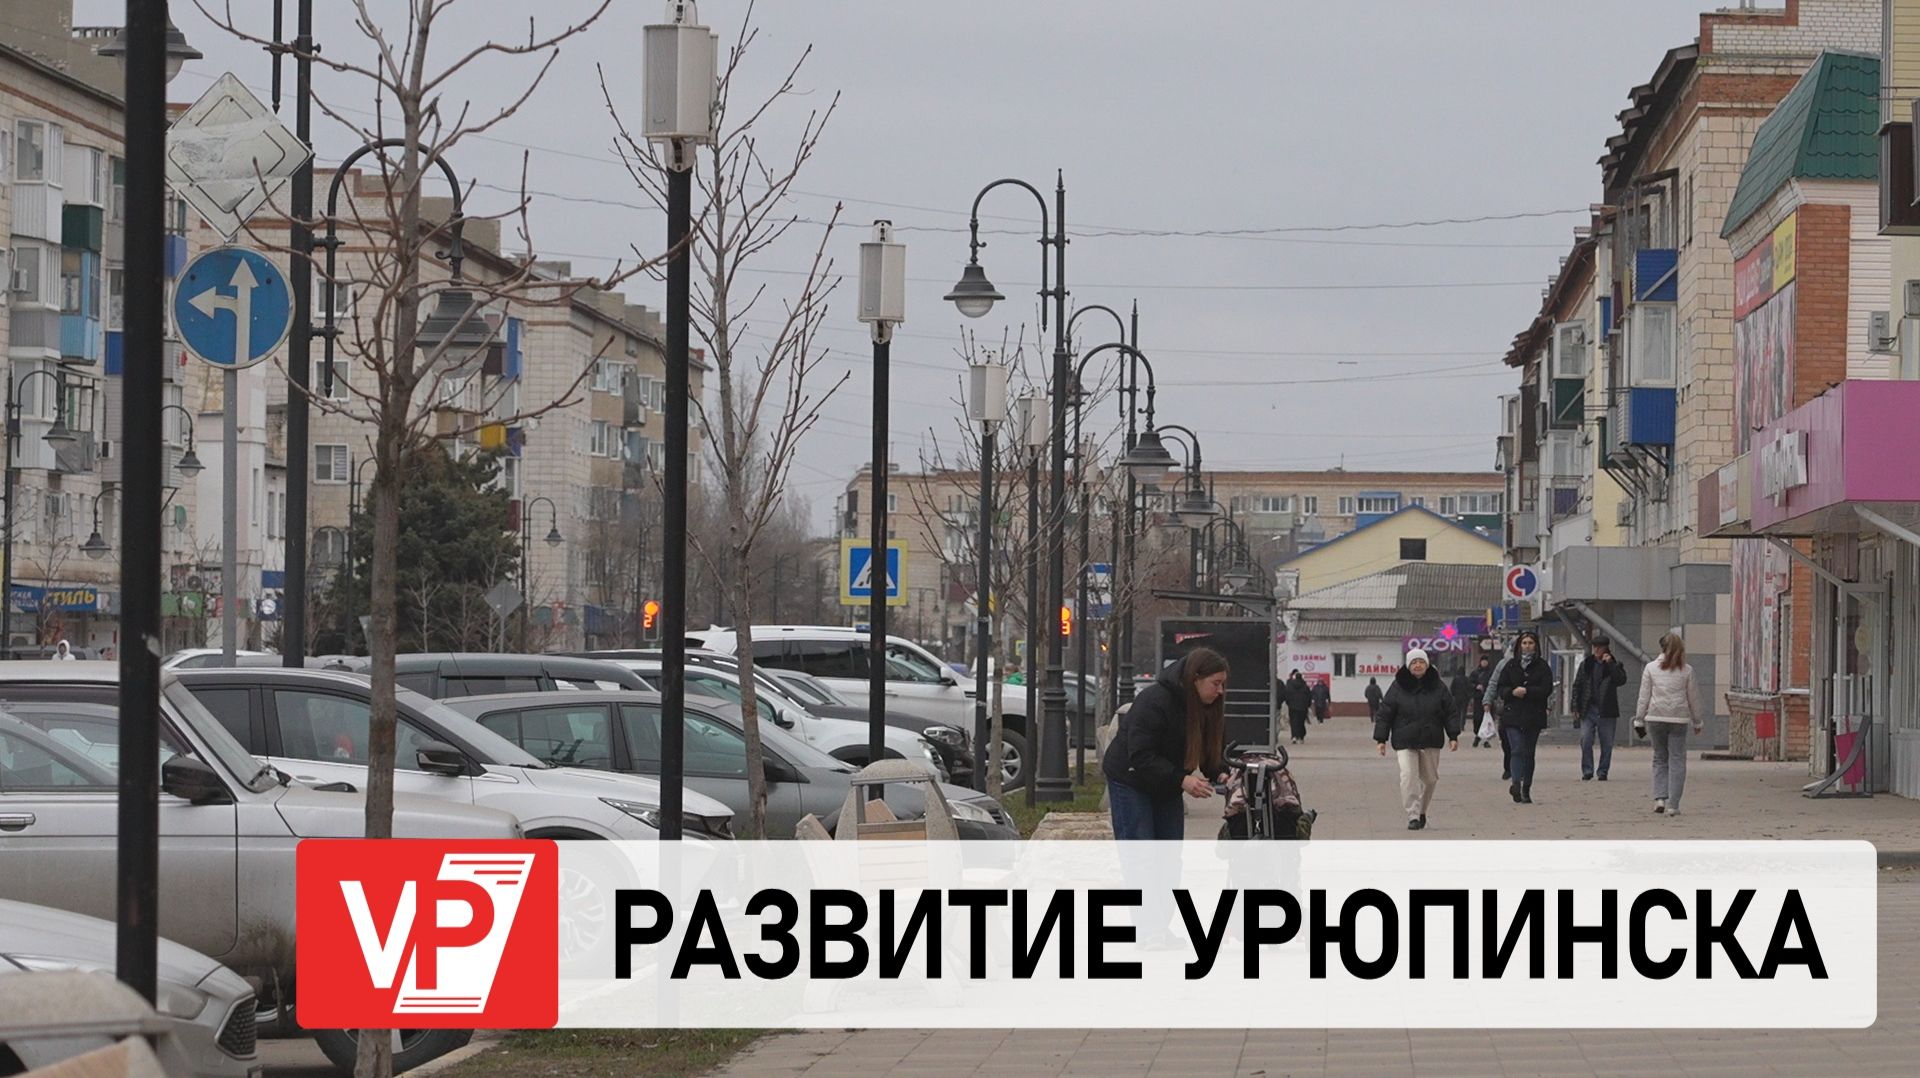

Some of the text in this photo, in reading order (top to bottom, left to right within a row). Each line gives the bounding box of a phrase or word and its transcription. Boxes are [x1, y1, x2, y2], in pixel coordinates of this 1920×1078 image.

[643, 614, 652, 628] 2
[1407, 638, 1463, 651] OZON
[1359, 663, 1400, 673] ЗАЙМЫ
